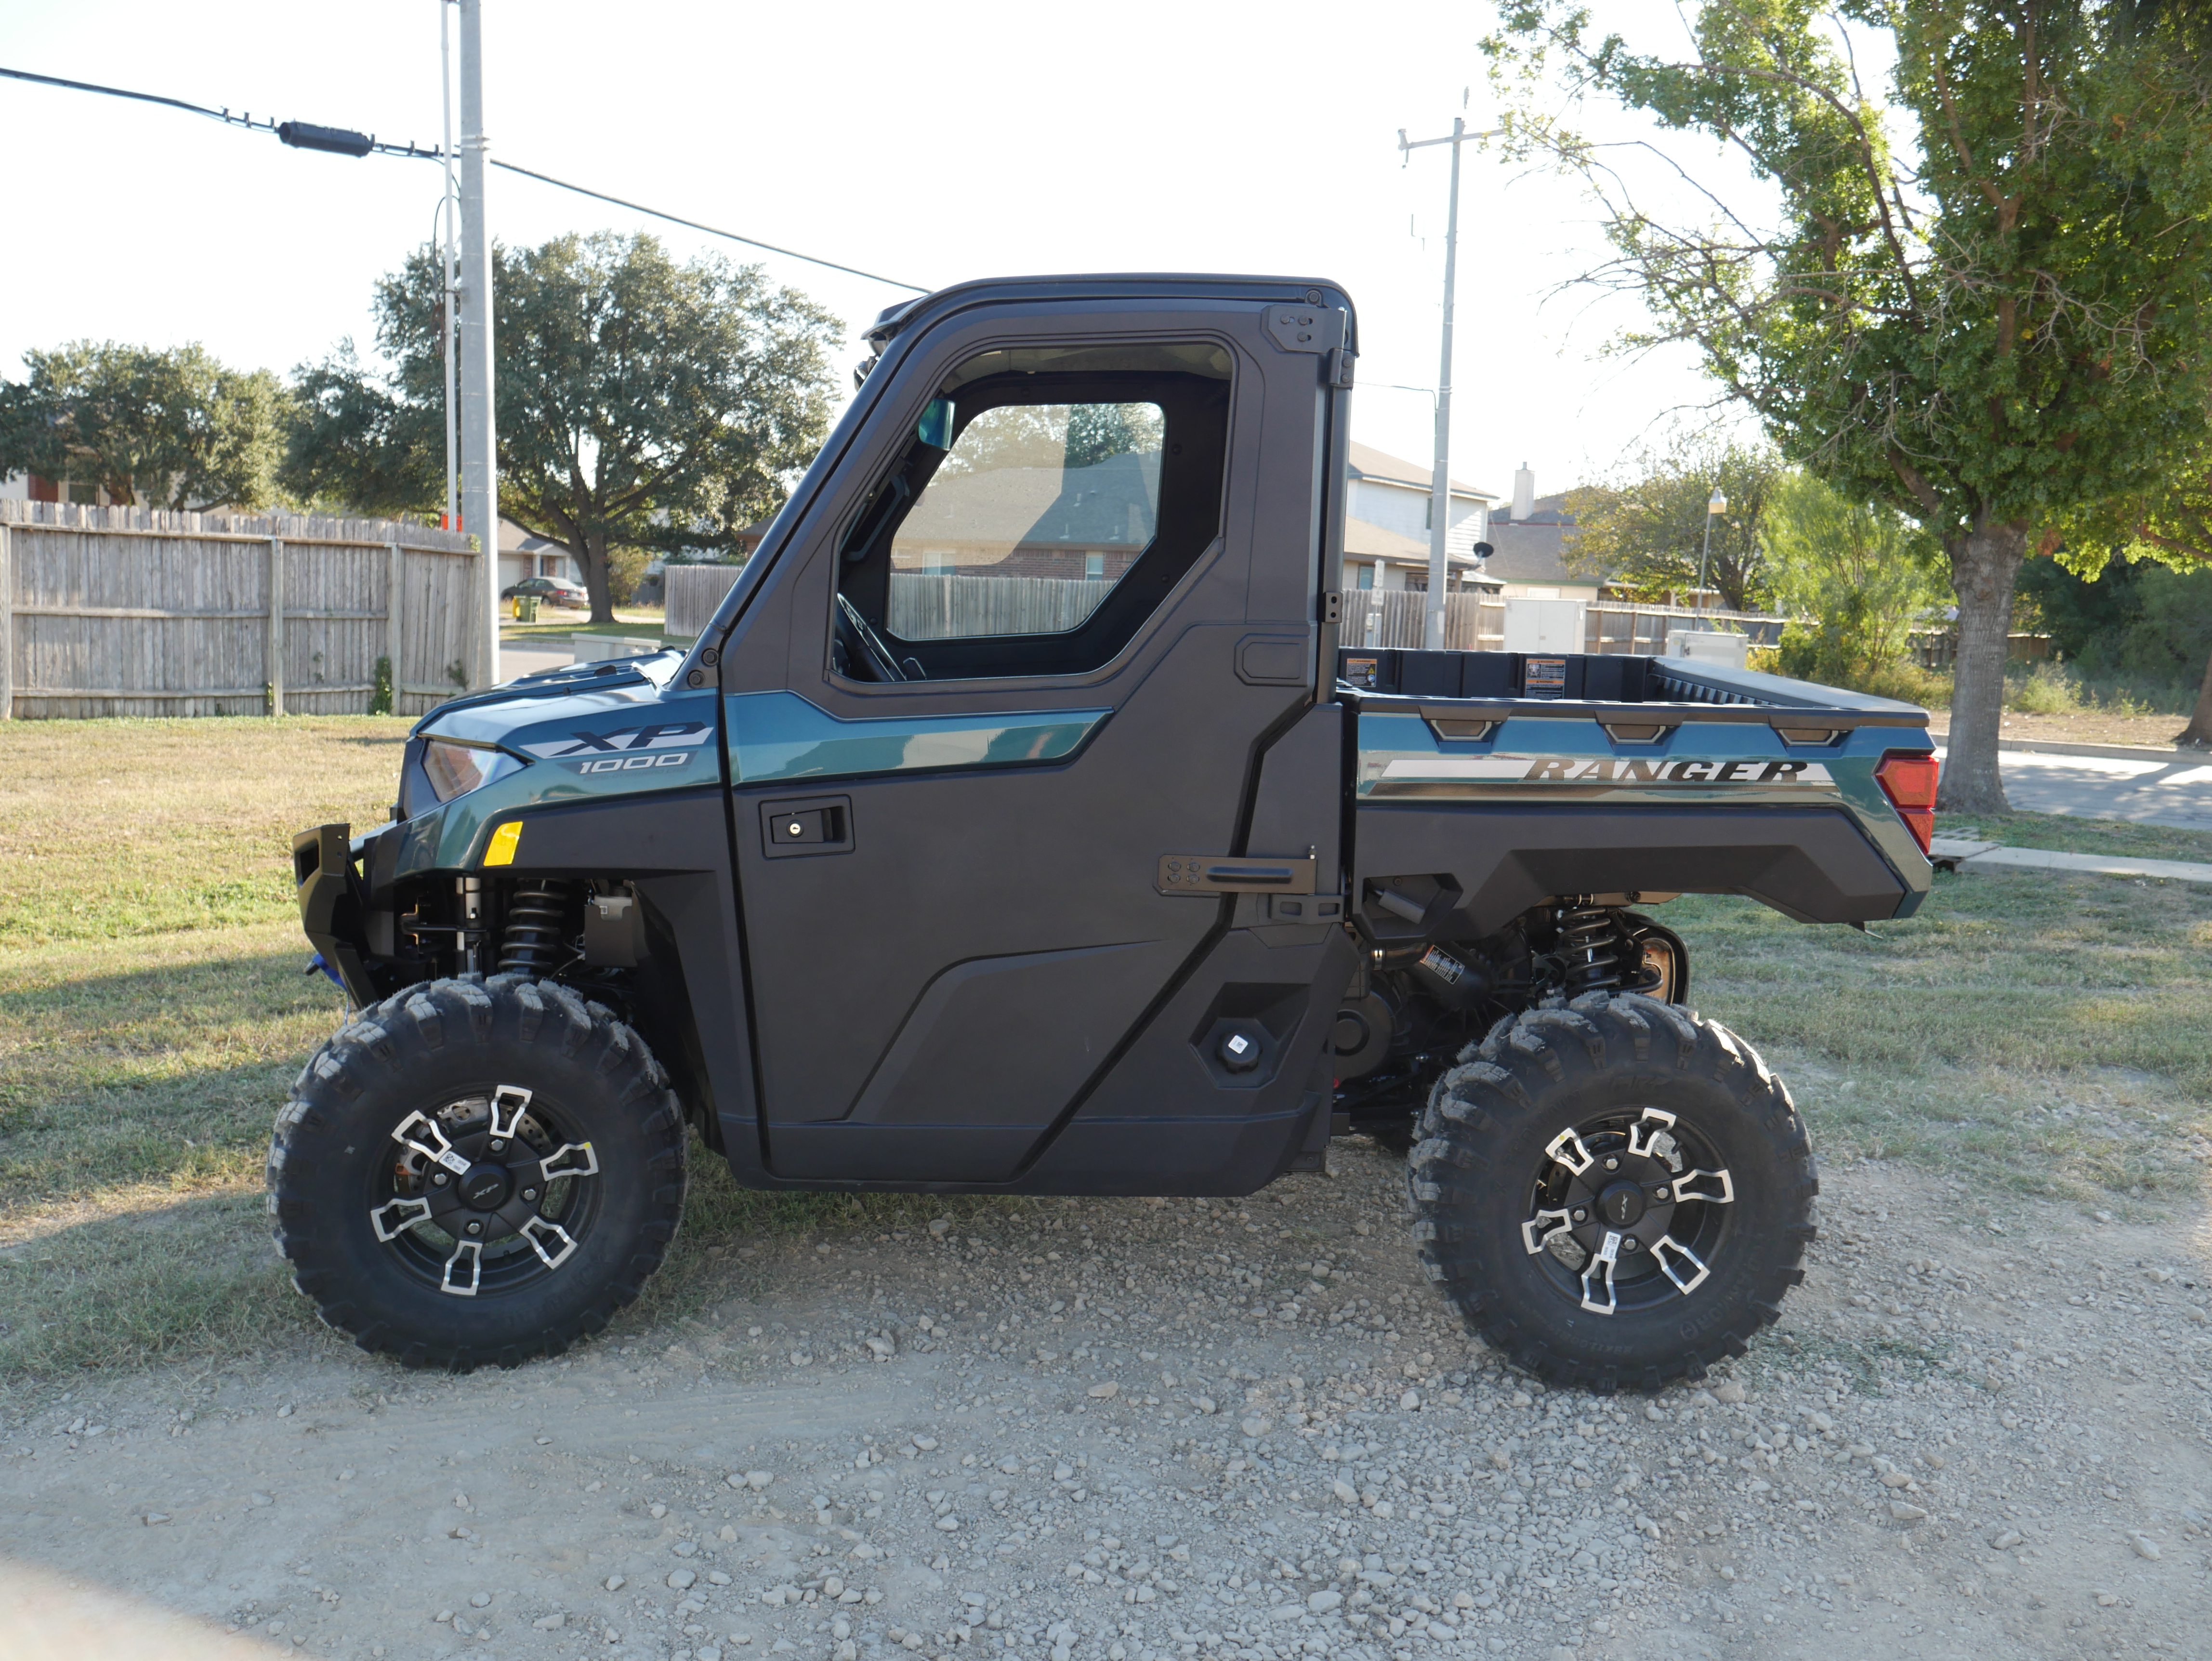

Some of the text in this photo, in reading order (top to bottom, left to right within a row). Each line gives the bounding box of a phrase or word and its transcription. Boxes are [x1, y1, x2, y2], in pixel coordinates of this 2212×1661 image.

[548, 721, 707, 757] XP
[579, 752, 688, 774] 1000
[1523, 759, 1807, 782] RANGER
[473, 1183, 499, 1200] XP
[1621, 1194, 1628, 1219] XP
